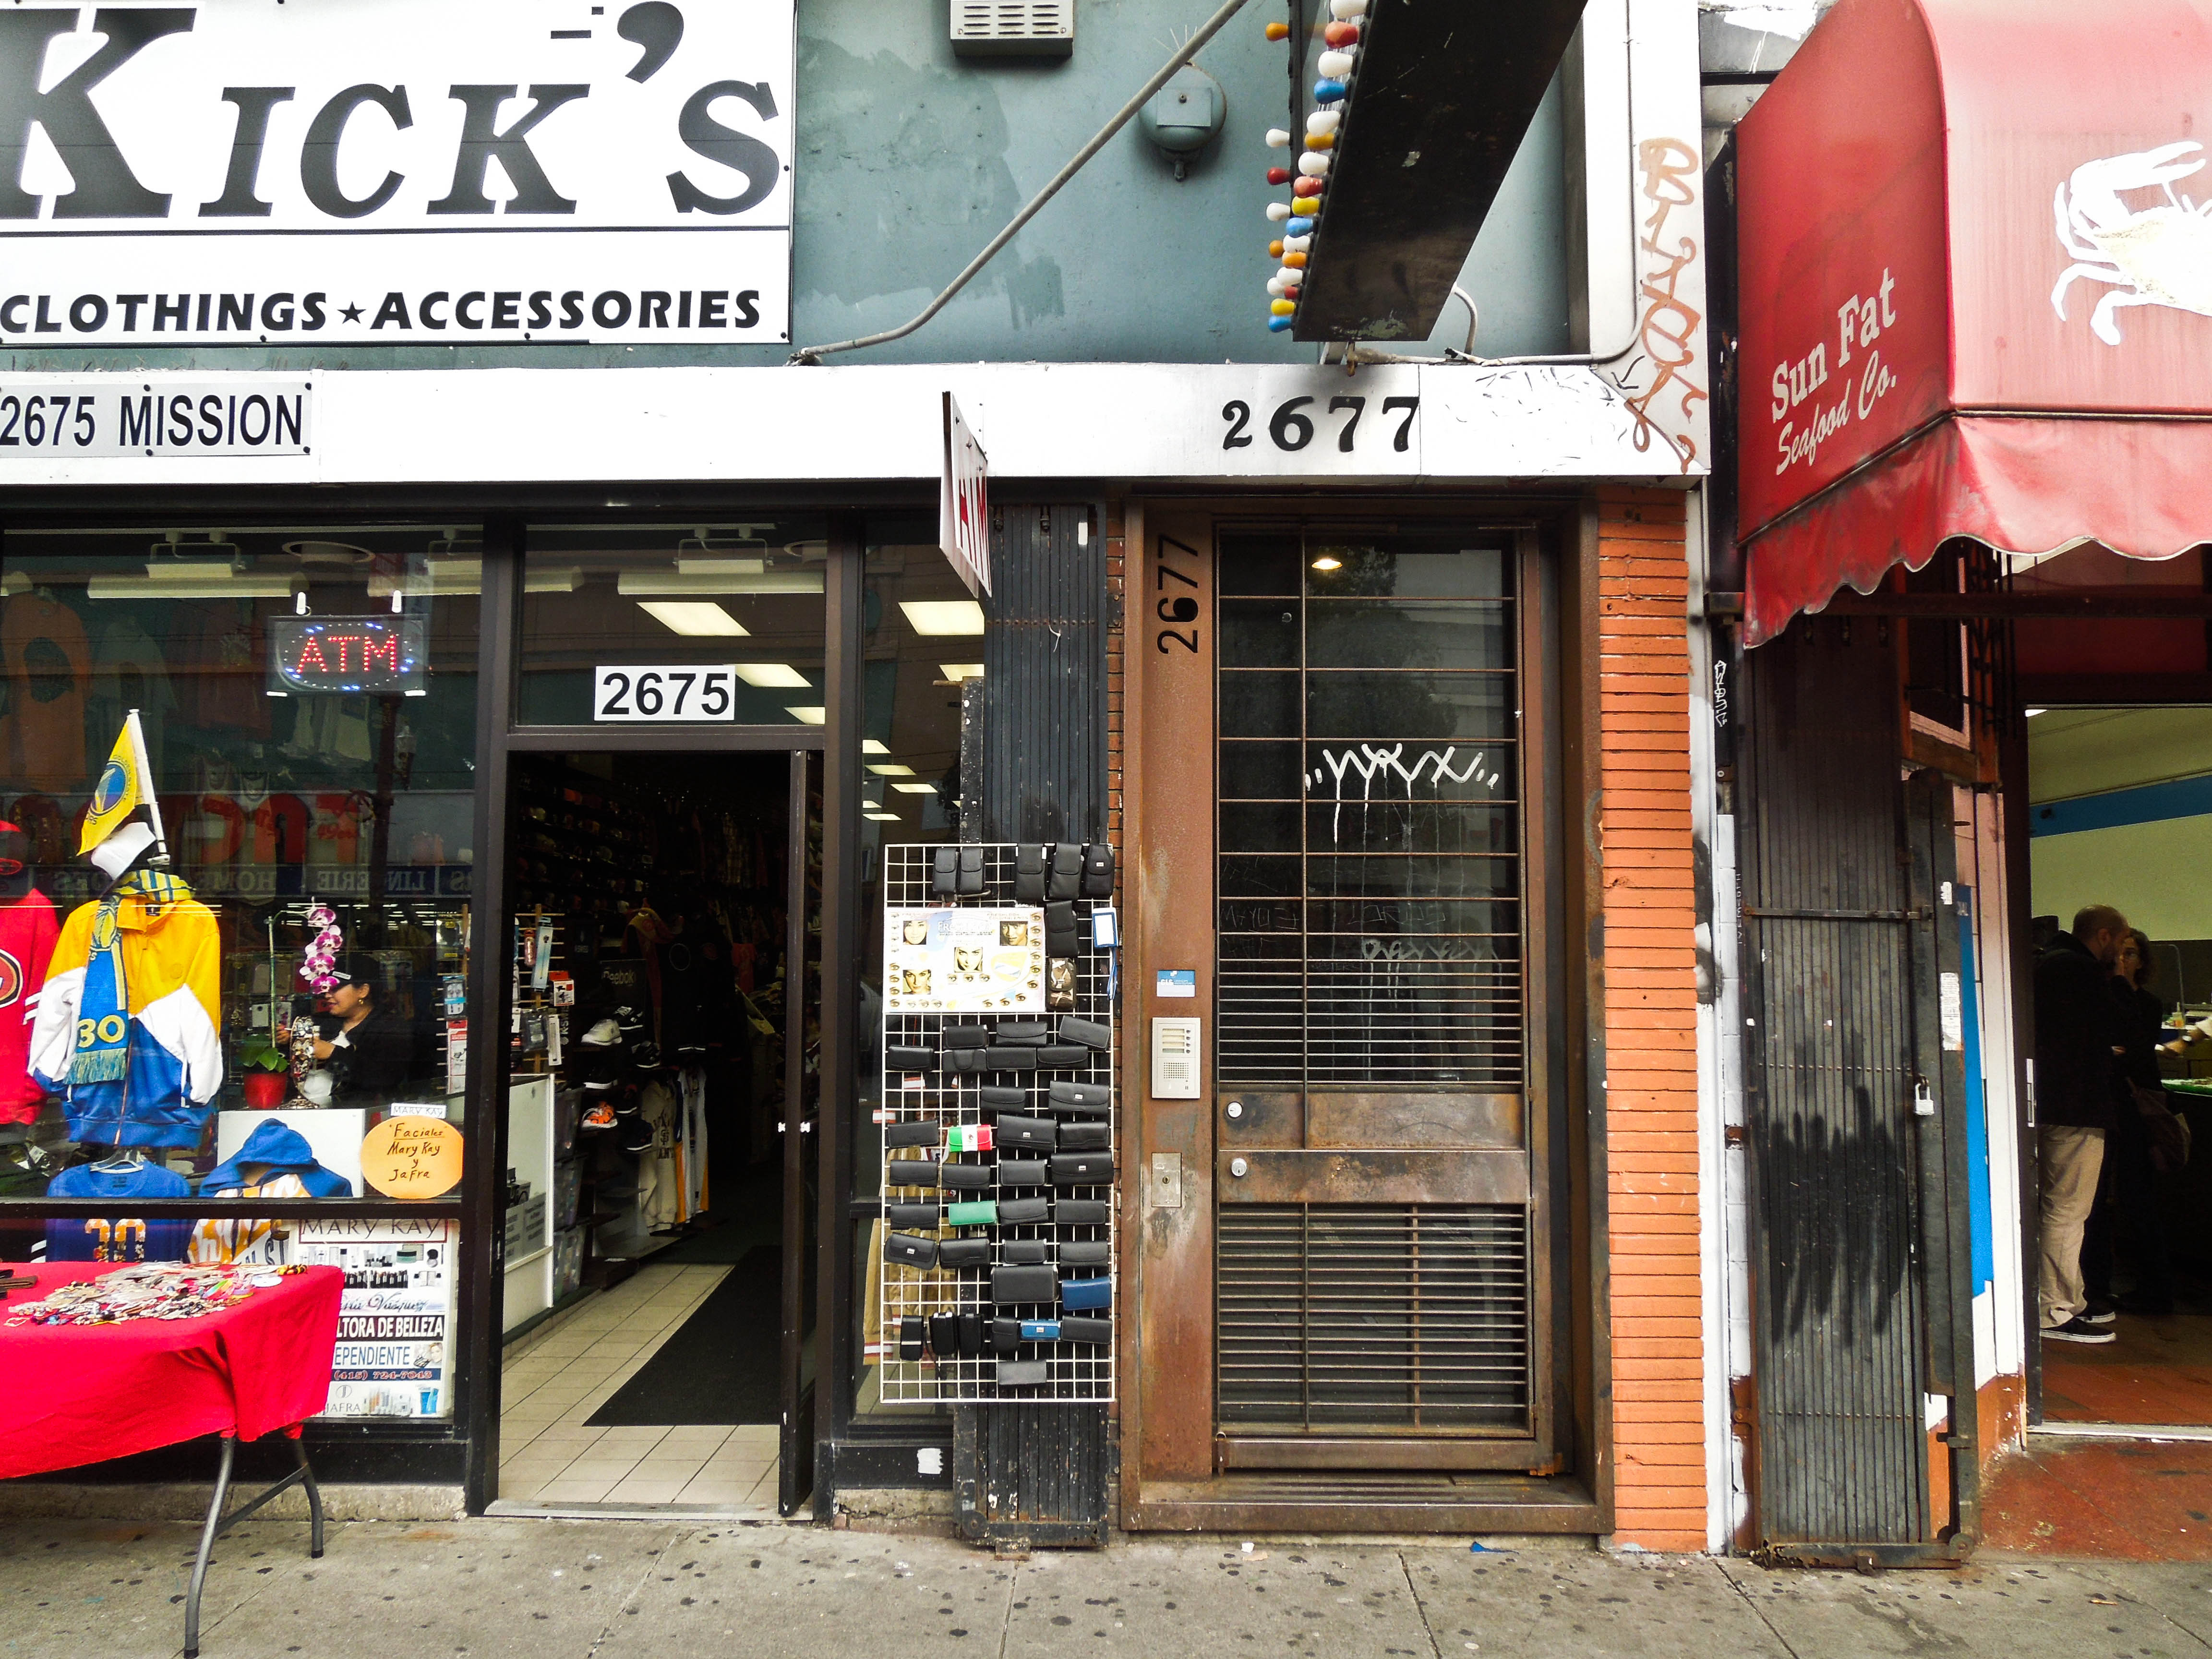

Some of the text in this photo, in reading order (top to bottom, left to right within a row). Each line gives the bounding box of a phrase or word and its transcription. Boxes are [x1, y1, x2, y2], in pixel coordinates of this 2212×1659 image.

[0, 290, 761, 334] CLOTHINGS ACCESSORIES
[1772, 266, 1896, 423] Sun Fat
[0, 393, 303, 447] 2675 MISSION
[1222, 396, 1419, 452] 2677
[1776, 349, 1897, 476] Seafood Co.
[1157, 534, 1198, 655] 2677
[295, 633, 397, 674] ATM
[601, 672, 729, 716] 2675
[78, 1014, 125, 1048] 30
[393, 1106, 443, 1118] MARY KAY
[387, 1141, 441, 1157] Mary Kay
[411, 1158, 419, 1169] y
[301, 1219, 441, 1239] MARY KAY
[336, 1316, 443, 1338] LTORA DE BELLEZA
[335, 1346, 410, 1366] EPENDIENTE
[334, 1370, 368, 1381] (415)
[325, 1403, 361, 1414] JAFRA
